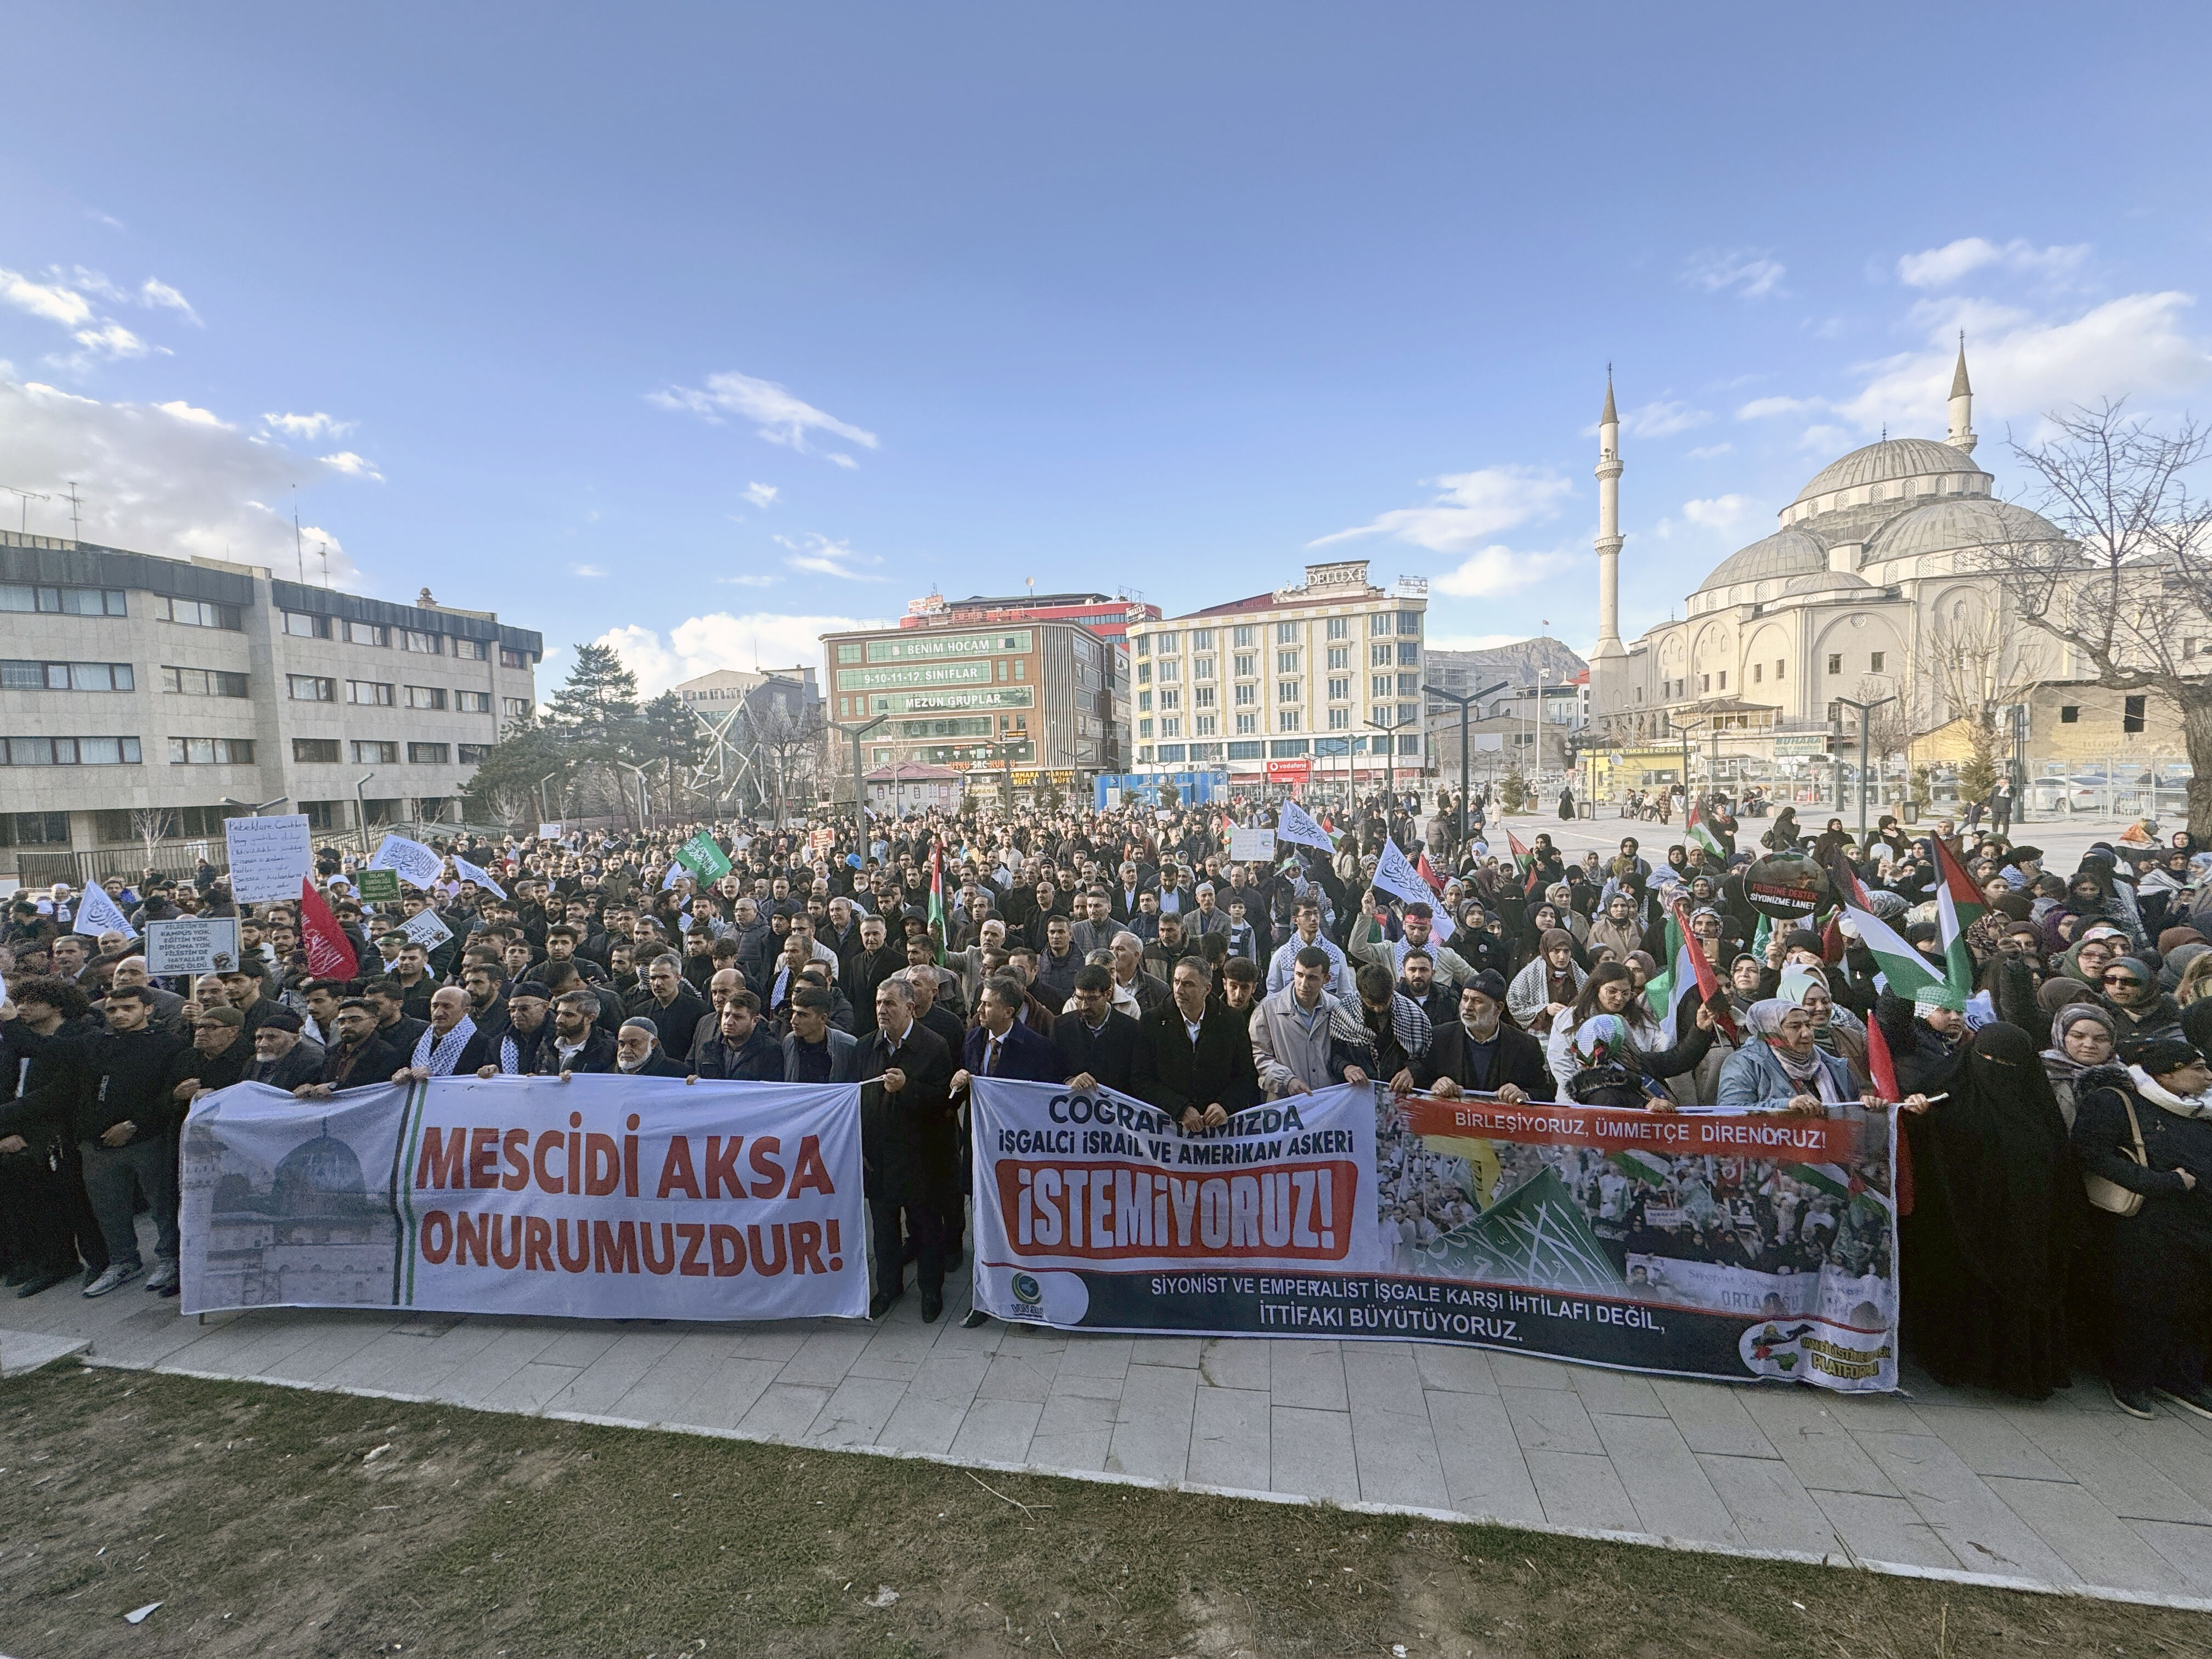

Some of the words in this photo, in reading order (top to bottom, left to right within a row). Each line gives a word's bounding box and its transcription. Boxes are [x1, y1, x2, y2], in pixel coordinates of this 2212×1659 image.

[1306, 568, 1367, 586] DELUXE
[1126, 604, 1146, 617] DELUXE
[908, 642, 943, 654] BENİM
[948, 640, 989, 652] HOCAM
[926, 668, 978, 680] SINIFLAR
[906, 697, 944, 708] MEZUN
[947, 694, 1001, 706] GRUPLAR
[950, 760, 970, 769] UTKU
[973, 760, 987, 769] SRC
[990, 759, 1015, 768] KURU
[1750, 892, 1791, 906] SİYONİZME
[1792, 900, 1816, 910] LANET
[1455, 1109, 1589, 1138] BİRLEŞİYORUZ,
[1595, 1117, 1689, 1144] ÜMMETÇE
[415, 1112, 641, 1198] MESCİDİ
[656, 1135, 835, 1200] AKSA
[999, 1129, 1075, 1154] İŞGALCİ
[1082, 1131, 1144, 1158] İSRAİL
[1148, 1139, 1171, 1163] VE
[1178, 1140, 1282, 1165] AMERİKAN
[1286, 1130, 1354, 1156] ASKERİ
[1018, 1167, 1335, 1250] İSTEMİYORUZ!
[420, 1210, 843, 1278] ONURUMUZDUR!
[1152, 1273, 1228, 1295] SİYONİST
[1232, 1277, 1255, 1294] VE
[1375, 1279, 1441, 1304] İŞGALE
[1446, 1288, 1503, 1312] KARŞI
[1509, 1290, 1590, 1322] İHTİLAFI
[1596, 1305, 1666, 1335] DEĞİL,
[1260, 1300, 1344, 1327] İTTİFAKI
[1350, 1304, 1523, 1342] BÜYÜTÜYORUZ.
[1812, 1352, 1880, 1380] PLATFORMU
